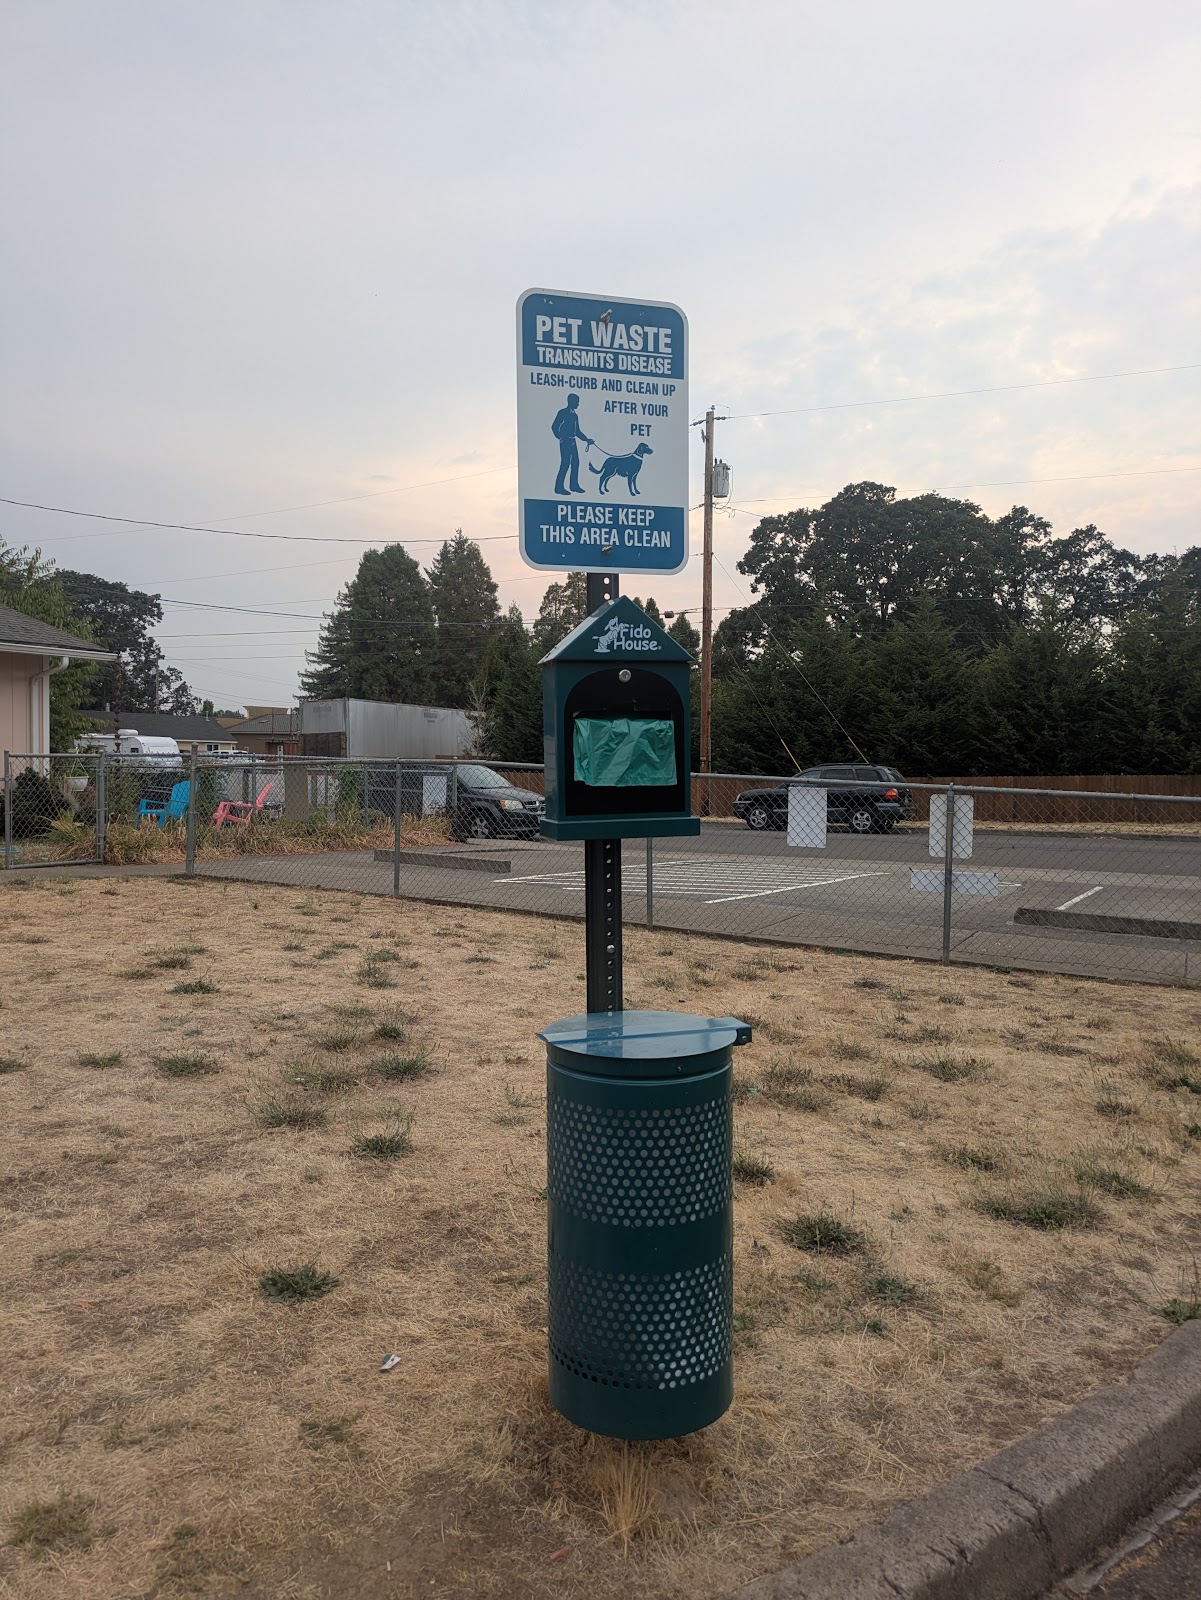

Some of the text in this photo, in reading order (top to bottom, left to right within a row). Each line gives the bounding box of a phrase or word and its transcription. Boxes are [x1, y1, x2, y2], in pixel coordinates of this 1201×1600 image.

[536, 314, 672, 353] PET WASTE
[537, 346, 672, 375] TRANSMITS DISEASE
[530, 371, 676, 397] LEASH-CURB AND CLEAN UP
[604, 400, 669, 417] AFTER YOUR
[630, 423, 652, 437] PET
[557, 504, 655, 526] PLEASE KEEP
[540, 524, 671, 548] THIS AREA CLEAN
[620, 623, 652, 638] Fido
[613, 636, 658, 651] House
